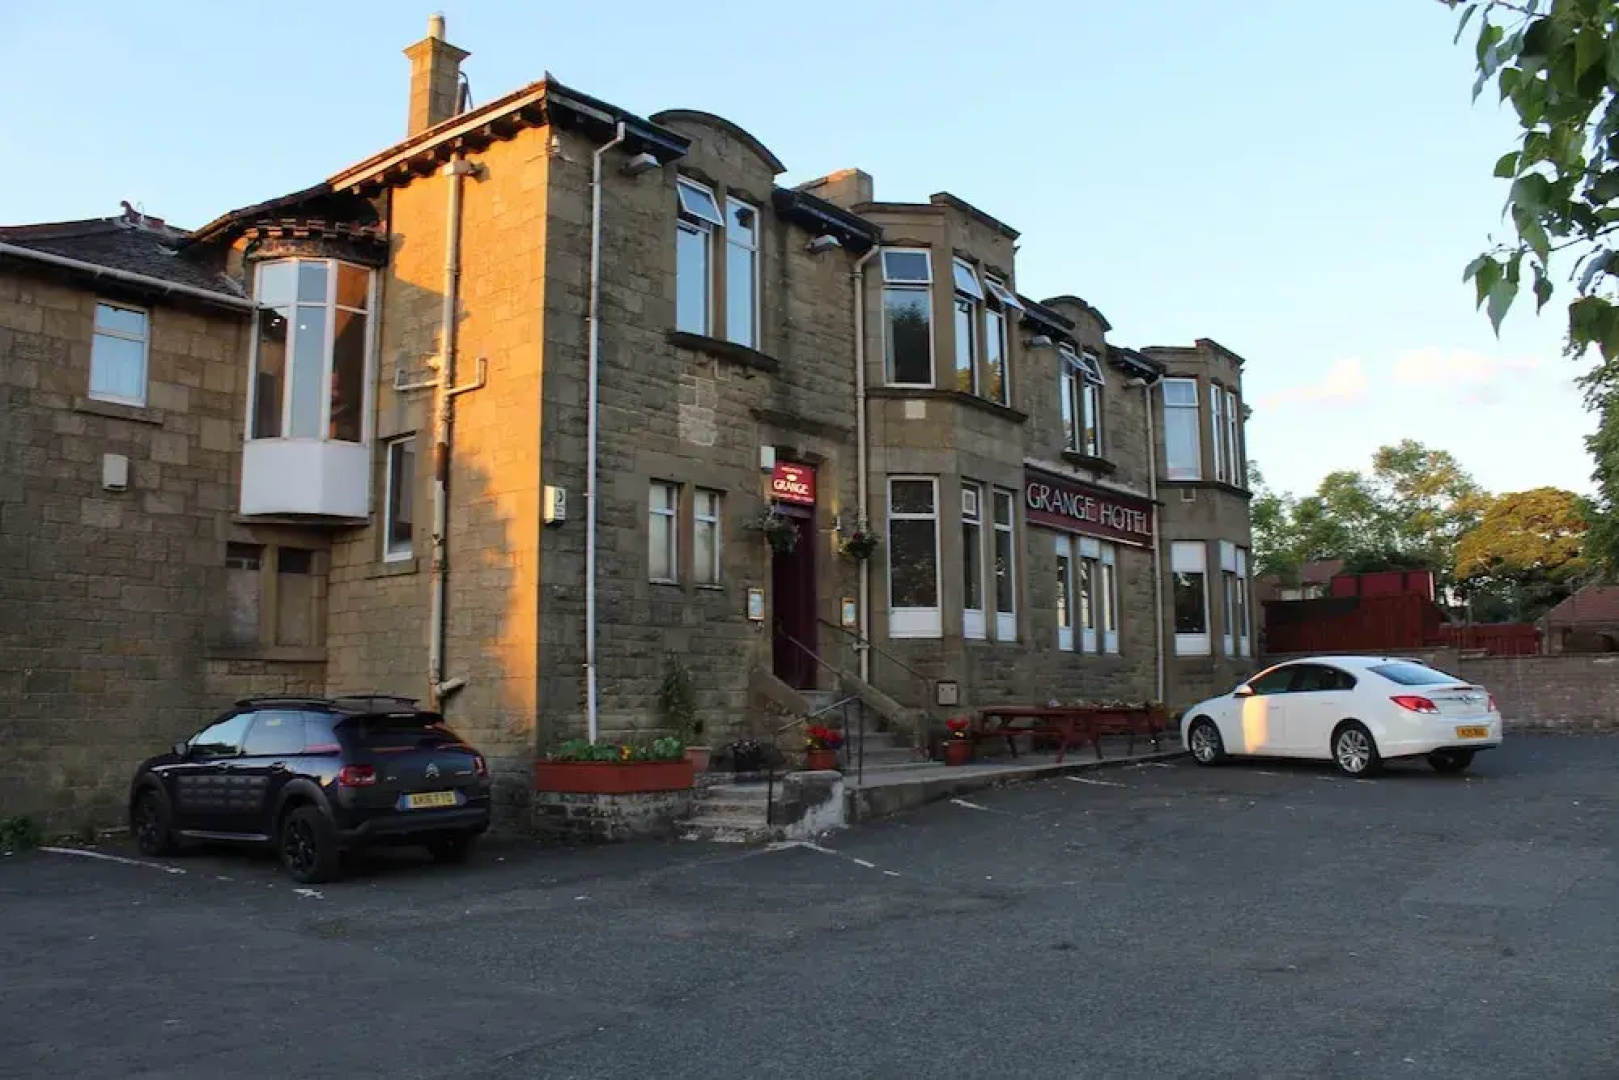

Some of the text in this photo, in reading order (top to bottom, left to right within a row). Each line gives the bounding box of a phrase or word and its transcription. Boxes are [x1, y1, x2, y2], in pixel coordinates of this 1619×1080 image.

[773, 479, 809, 495] GRANGE
[1027, 482, 1152, 536] GRANGE HOTEL
